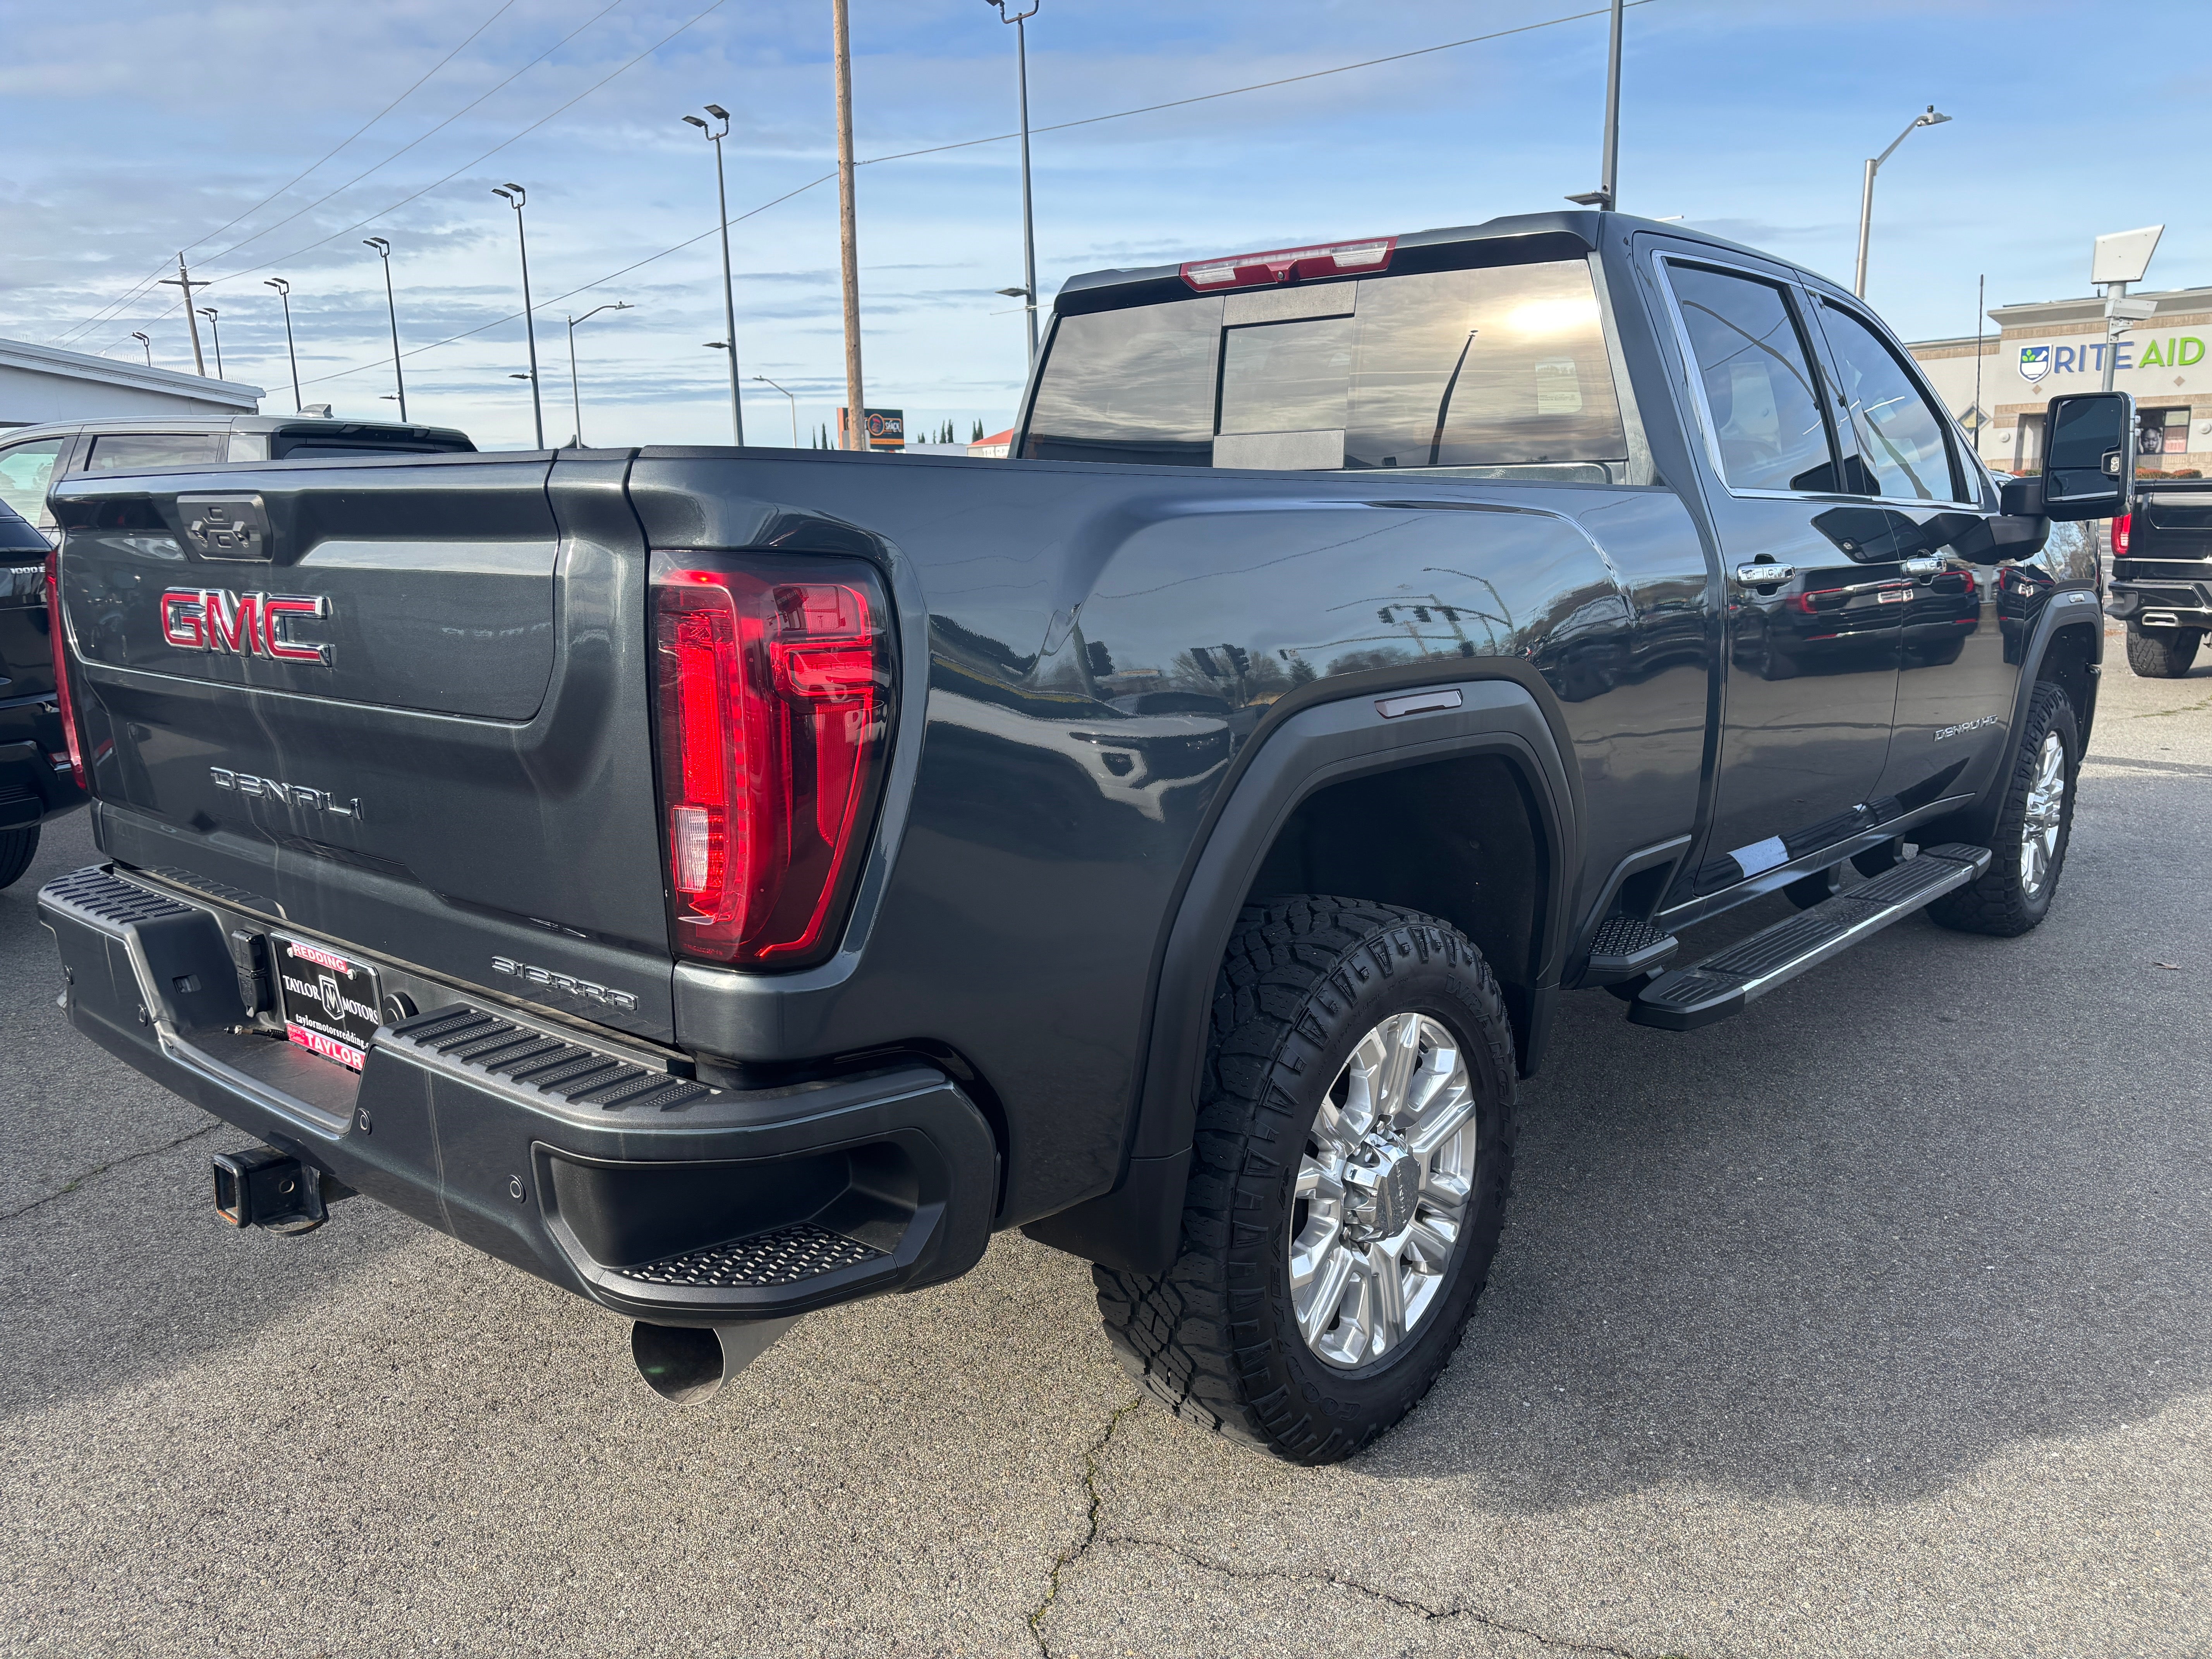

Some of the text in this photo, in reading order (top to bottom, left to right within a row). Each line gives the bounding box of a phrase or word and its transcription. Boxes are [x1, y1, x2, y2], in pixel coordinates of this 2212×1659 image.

[2054, 337, 2206, 374] RITE AID
[161, 587, 336, 667] GMC
[1933, 714, 1998, 742] DENALI HD
[210, 766, 364, 820] DENALI
[293, 943, 346, 971] REDDING
[283, 975, 322, 1001] TAYLOR
[342, 996, 378, 1025] MOTORS
[491, 955, 639, 1011] SIERRA
[305, 1032, 363, 1069] TAYLOR
